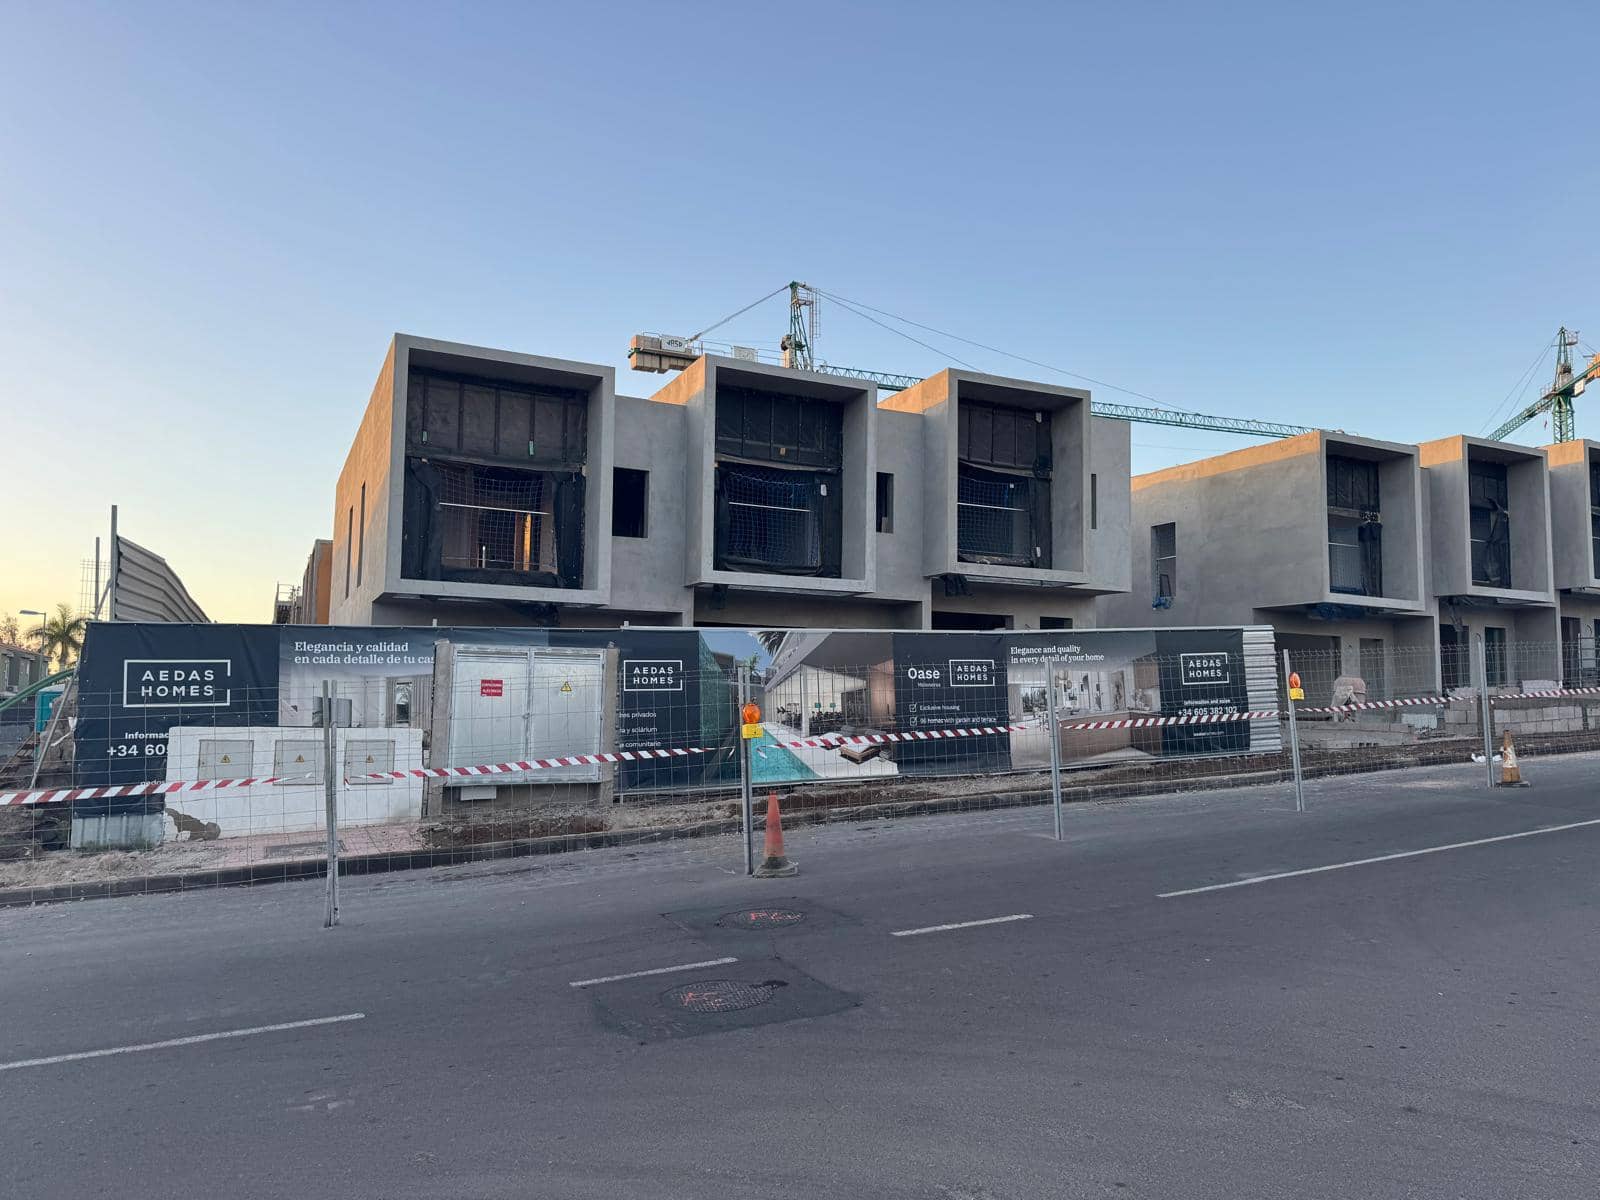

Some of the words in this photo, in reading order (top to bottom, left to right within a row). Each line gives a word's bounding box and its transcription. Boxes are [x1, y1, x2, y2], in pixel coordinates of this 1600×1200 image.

[294, 641, 353, 654] Elegancia
[355, 643, 364, 654] y
[365, 641, 409, 652] calidad
[1010, 646, 1042, 655] Elegance
[1043, 645, 1057, 653] and
[1057, 645, 1081, 654] quality
[294, 656, 310, 664] en
[312, 654, 341, 664] cada
[343, 654, 385, 664] detalle
[386, 654, 401, 664] de
[403, 655, 415, 664] tu
[1011, 656, 1019, 664] in
[1060, 654, 1069, 662] of
[1068, 655, 1085, 663] your
[1085, 653, 1105, 661] home
[1188, 659, 1222, 668] AEDAS
[633, 666, 674, 675] AEDAS
[908, 667, 940, 680] Oase
[1188, 669, 1222, 678] HOMES
[141, 670, 214, 682] AEDAS
[633, 676, 674, 685] HOMES
[141, 685, 214, 697] HOMES
[1178, 708, 1192, 717] +34
[1194, 707, 1208, 716] 605
[107, 744, 139, 757] +34
[145, 744, 169, 756] 60
